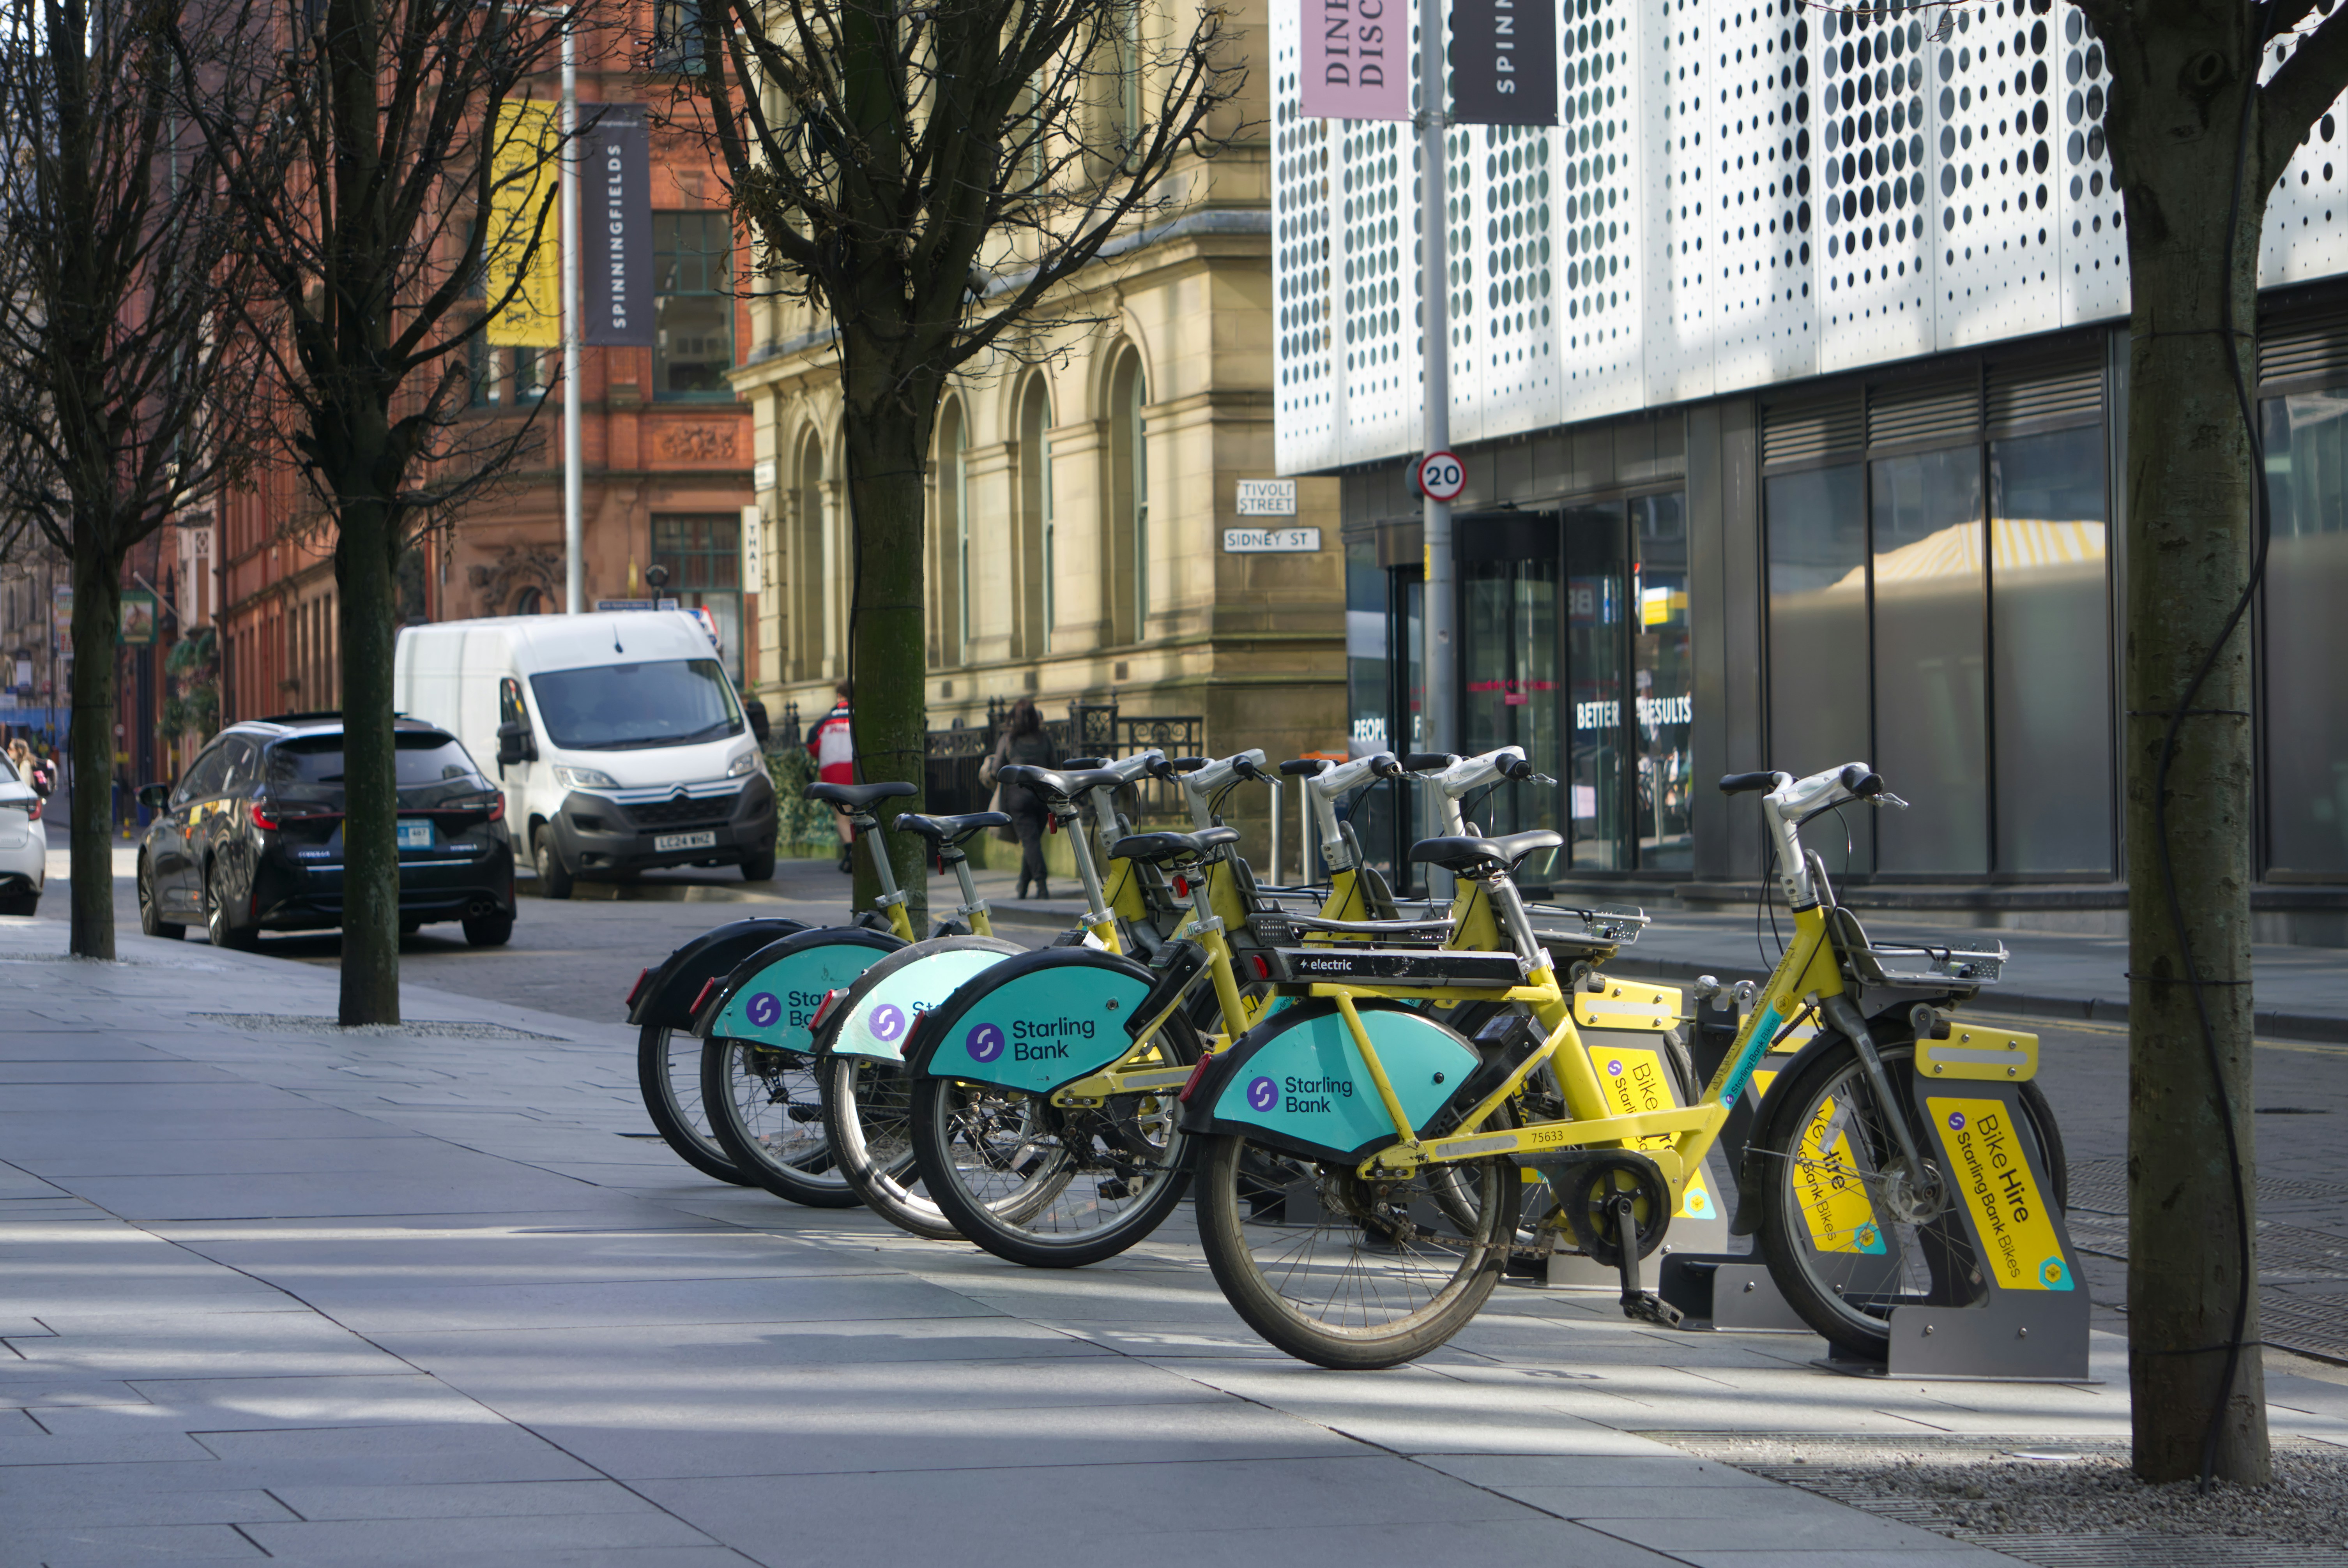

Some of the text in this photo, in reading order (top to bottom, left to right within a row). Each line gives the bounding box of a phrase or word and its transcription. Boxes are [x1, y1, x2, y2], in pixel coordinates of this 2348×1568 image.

[607, 145, 626, 329] SPINNINGFIELDS
[1427, 464, 1460, 486] 20
[1243, 483, 1292, 496] TIVOLI
[1240, 498, 1293, 510] STREET
[748, 524, 757, 574] THAI
[1228, 532, 1307, 546] SIDNEY ST
[1577, 696, 1692, 729] BETTER RESULTS
[1354, 717, 1387, 742] PEOPL
[1310, 959, 1352, 970] electric
[1013, 1017, 1095, 1039] Starling
[1014, 1039, 1070, 1061] Bank
[1731, 1059, 1753, 1094] Starling
[1749, 1040, 1765, 1063] Bank
[1761, 1017, 1777, 1042] Bikes
[1285, 1076, 1353, 1097] Starling
[1615, 1077, 1637, 1114] Starli
[1633, 1063, 1658, 1110] Bike
[1286, 1096, 1331, 1112] Bank
[1531, 1130, 1563, 1143] 75633
[1977, 1114, 2029, 1223] Bike Hire
[1957, 1132, 2021, 1278] Starling Bank Bikes
[1817, 1201, 1836, 1241] Bikes
